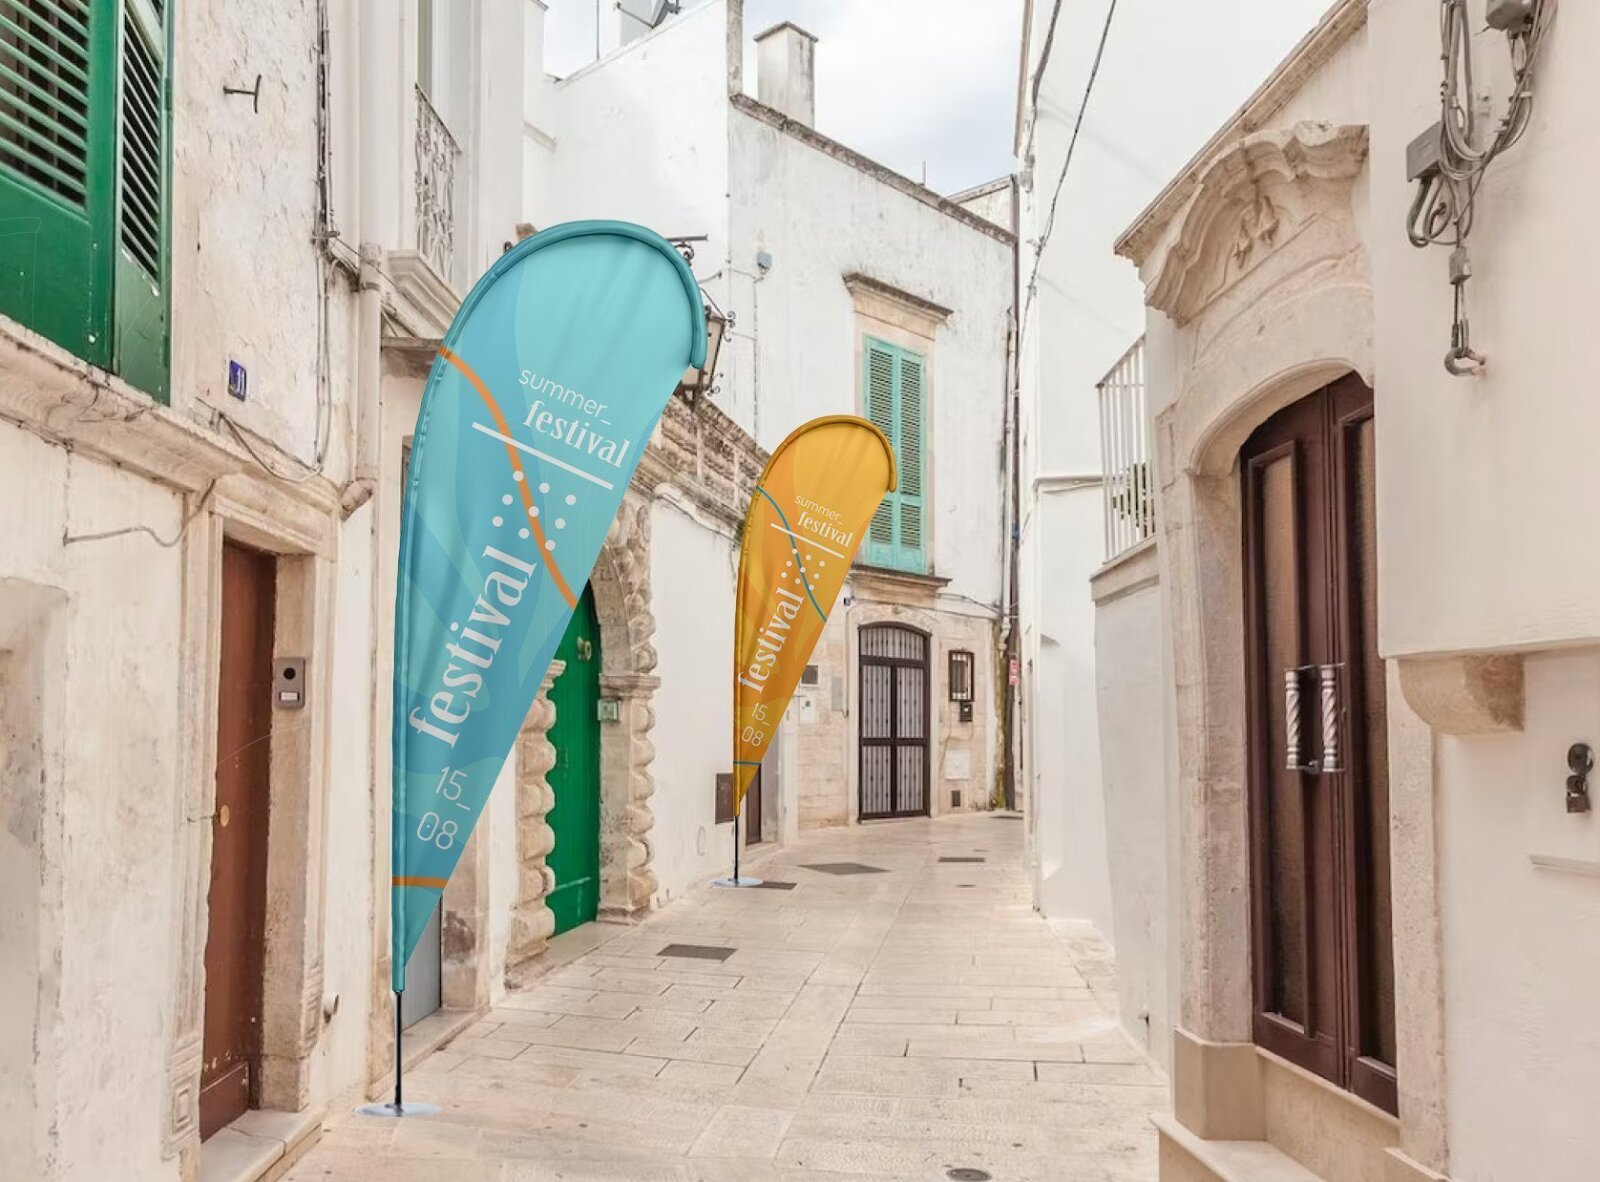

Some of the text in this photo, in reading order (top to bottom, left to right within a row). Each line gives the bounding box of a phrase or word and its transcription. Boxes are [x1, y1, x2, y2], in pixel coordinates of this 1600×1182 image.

[518, 368, 612, 426] summer_
[522, 400, 630, 468] festival
[794, 495, 845, 526] summer_
[796, 510, 854, 548] festival
[409, 545, 537, 749] festival
[737, 587, 805, 693] festival
[751, 702, 771, 727] 15_
[741, 726, 764, 747] 08
[435, 765, 471, 811] 15_
[416, 811, 459, 851] 08
